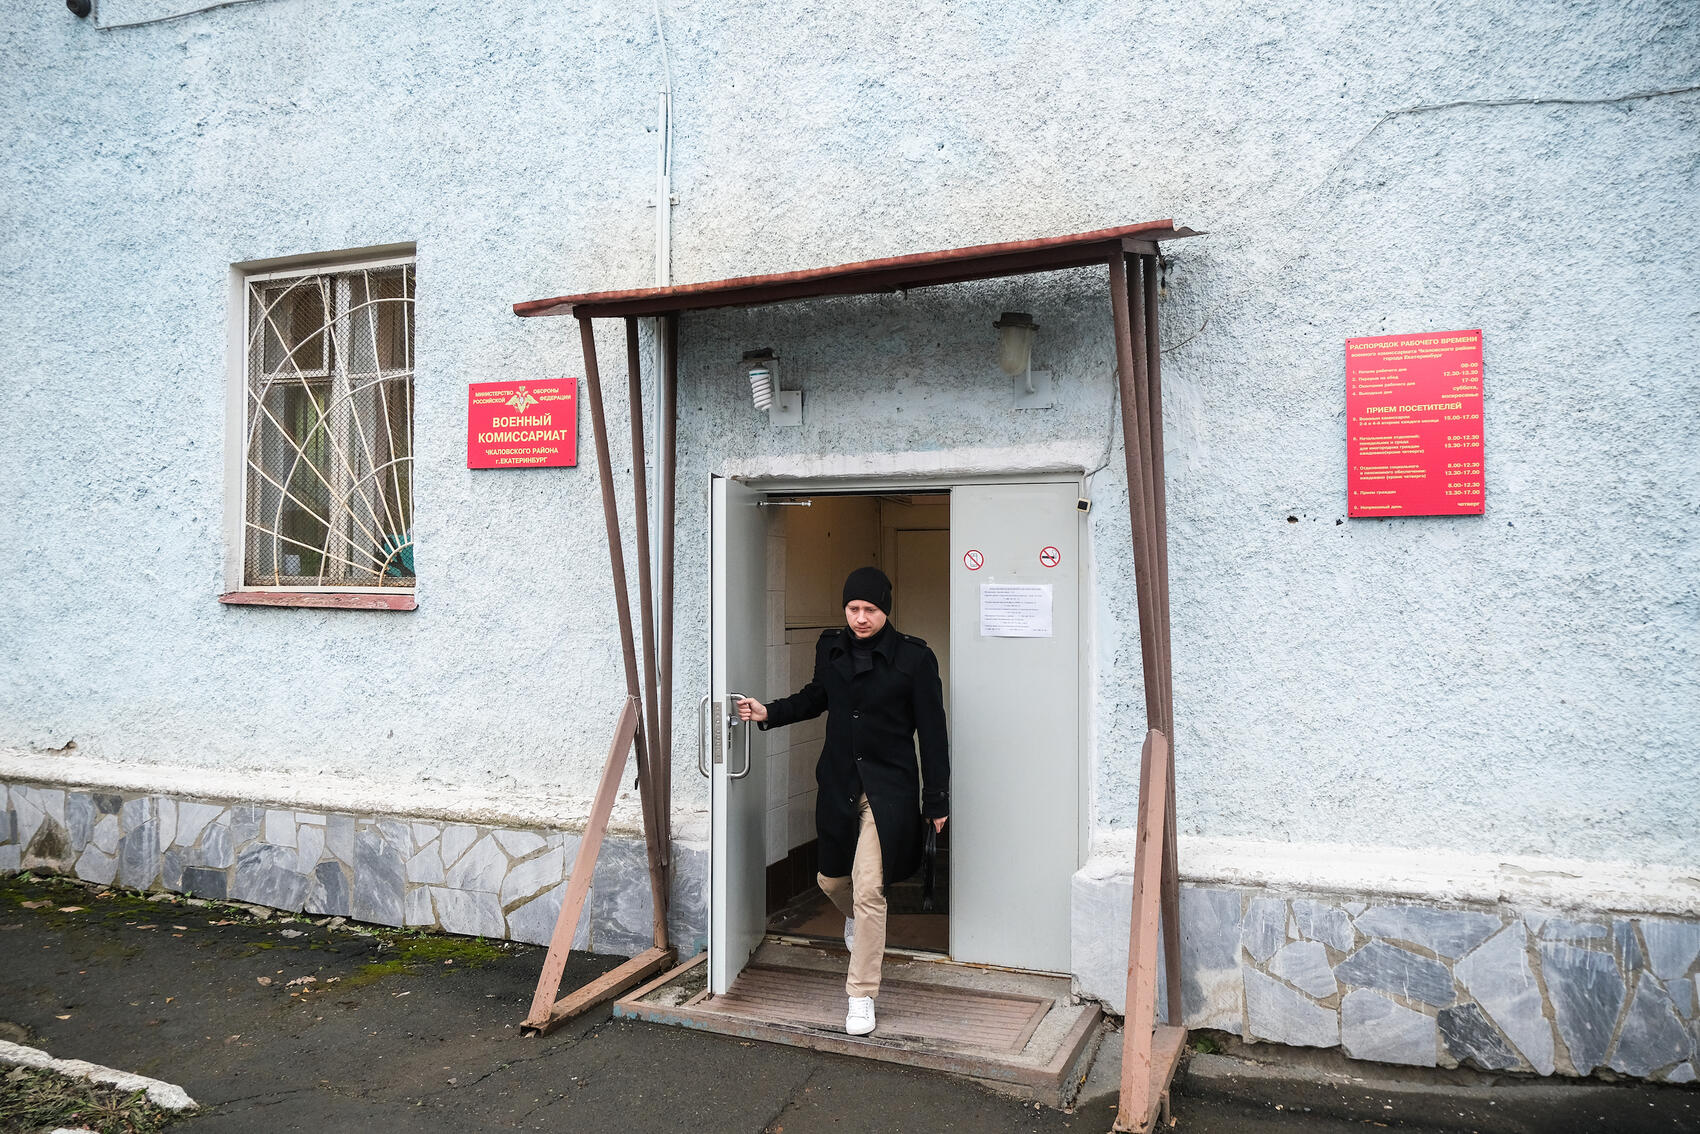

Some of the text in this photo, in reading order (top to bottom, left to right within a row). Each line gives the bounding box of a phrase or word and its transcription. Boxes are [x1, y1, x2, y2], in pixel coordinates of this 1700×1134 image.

[1350, 336, 1478, 350] РАСПОРЯДОК РАБОЧЕГО ВРЕМЕНИ
[472, 394, 571, 405] РОССИЙСКОЙ ФЕДЕРАЦИИ
[1366, 401, 1462, 414] ПРИЕМ ПОСЕТИТЕЛЕЙ
[492, 412, 552, 428] ВОЕННЫЙ
[478, 429, 567, 443] КОМИССАРИАТ
[485, 446, 559, 456] ЧКАЛОВСКОГО РАЙОНА
[495, 456, 548, 465] г.ЕКАТЕРИНБУРГ
